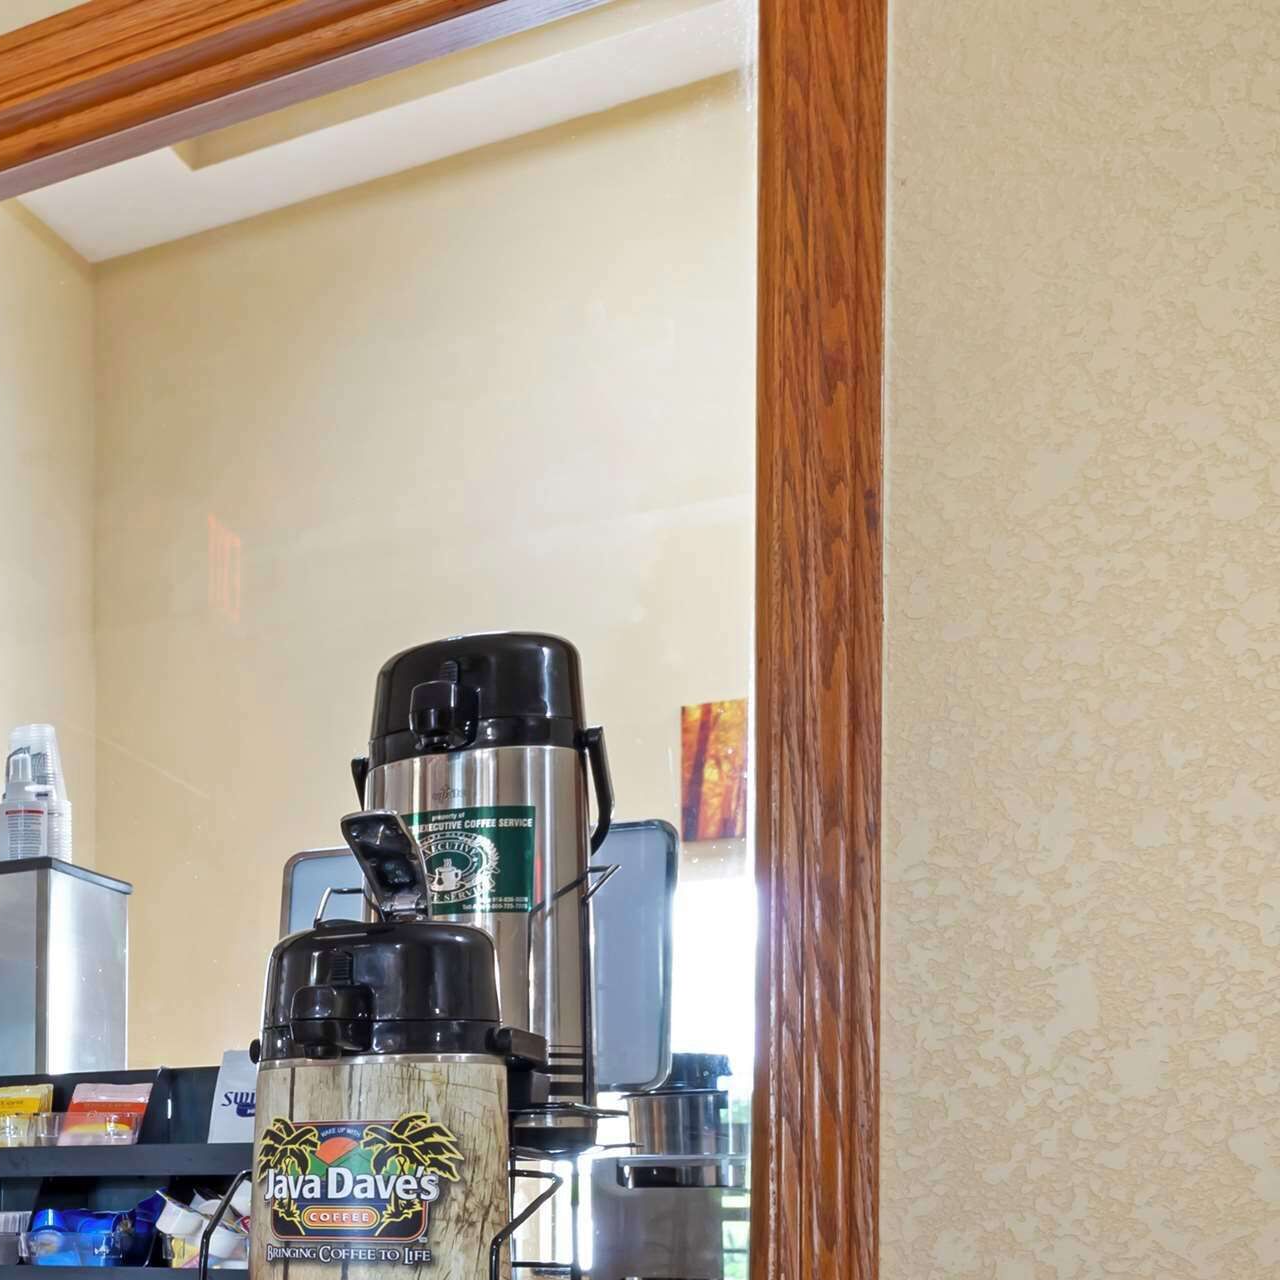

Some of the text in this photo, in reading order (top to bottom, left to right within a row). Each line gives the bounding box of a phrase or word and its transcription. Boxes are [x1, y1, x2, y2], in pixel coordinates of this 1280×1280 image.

[464, 818, 497, 829] COFFEE
[498, 817, 533, 828] SERVICE
[265, 1166, 440, 1201] Java Dave's
[309, 1212, 370, 1222] COFFEE
